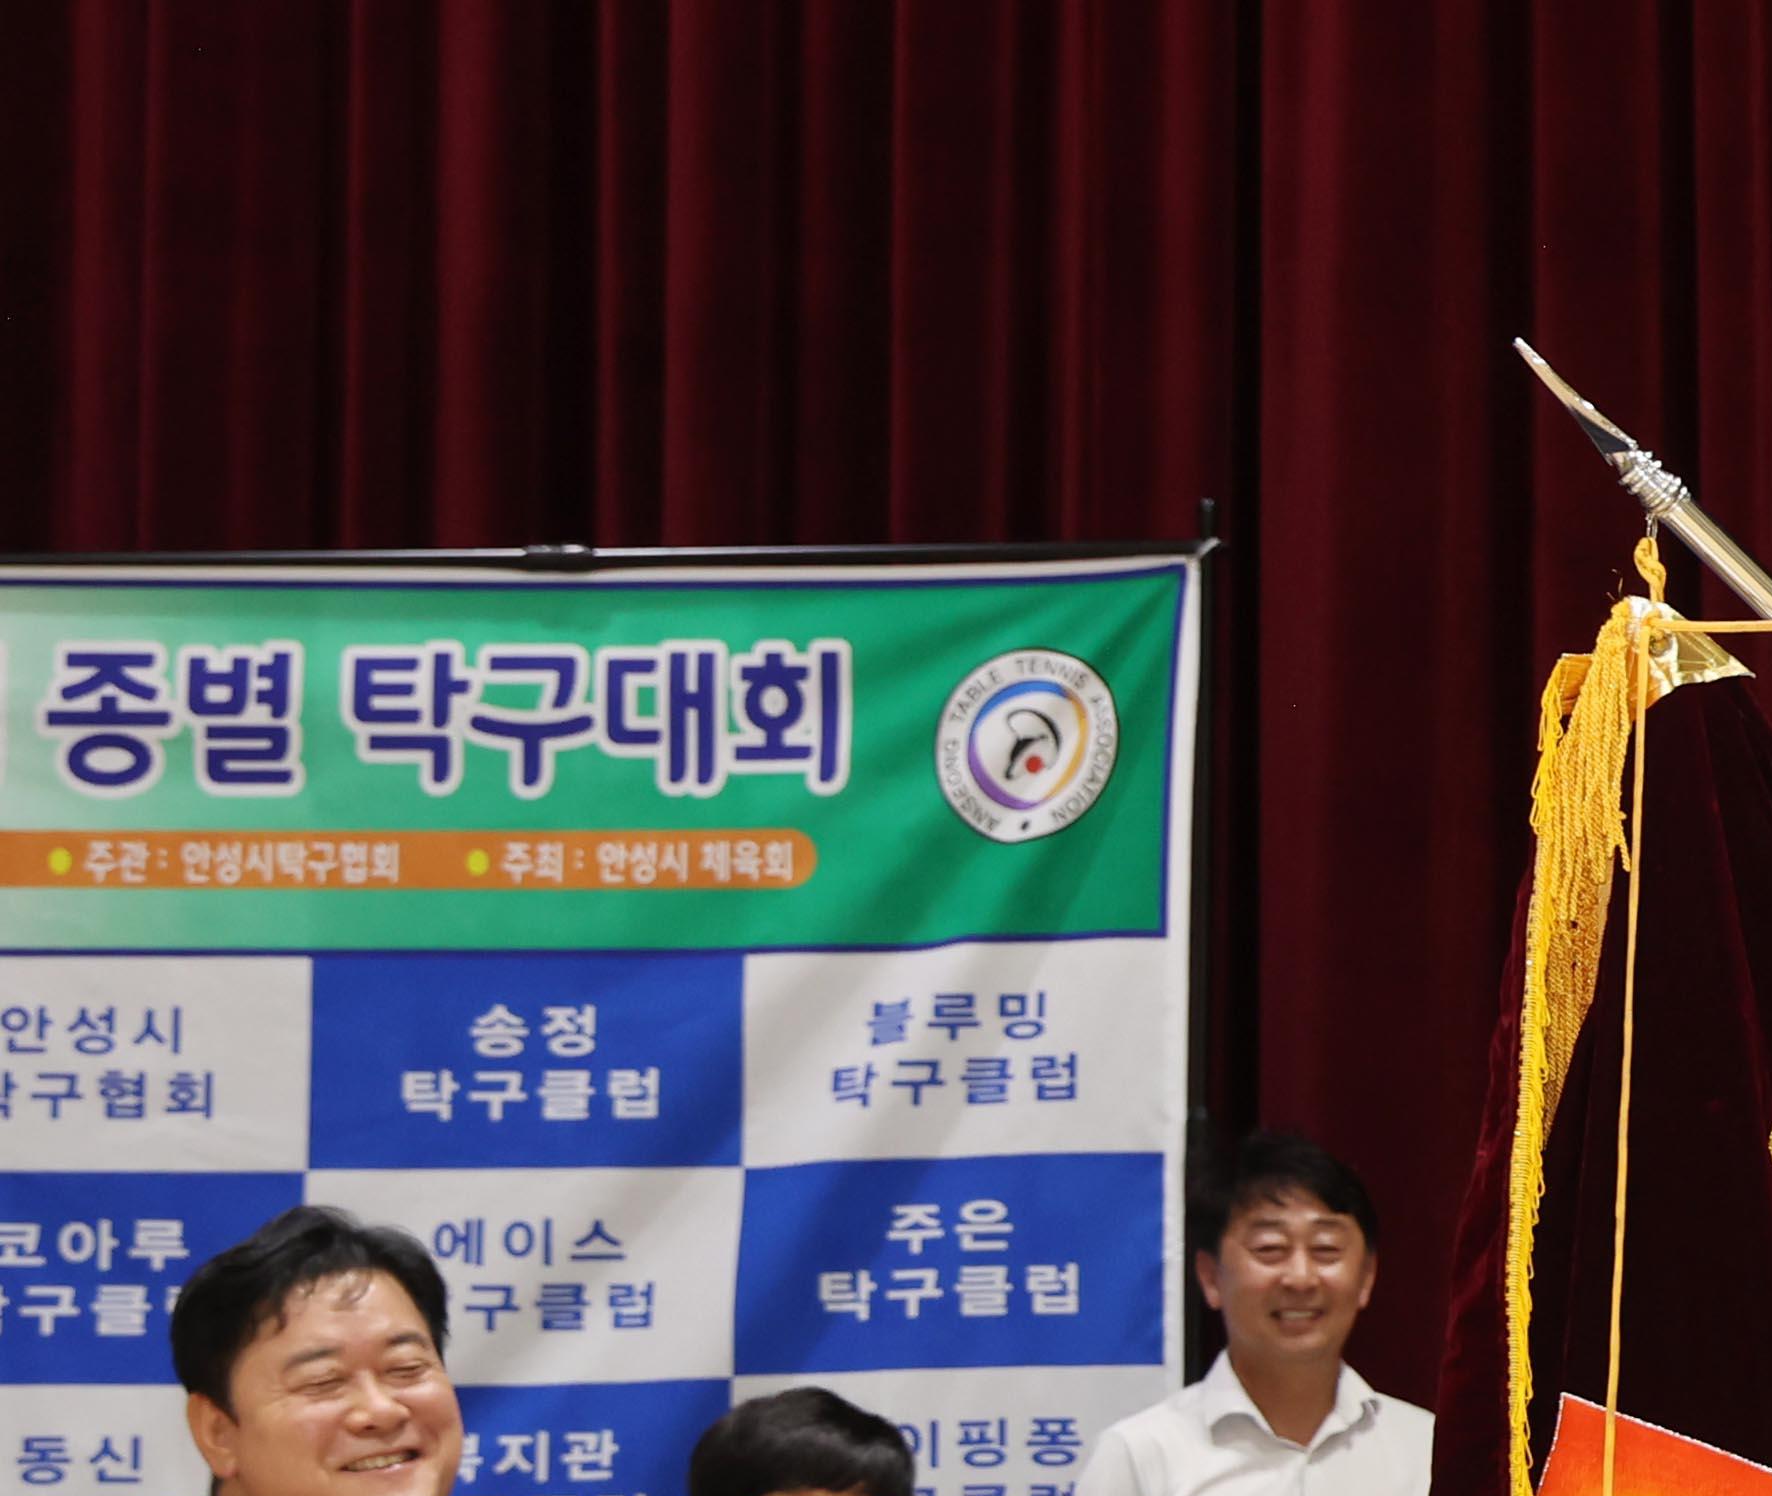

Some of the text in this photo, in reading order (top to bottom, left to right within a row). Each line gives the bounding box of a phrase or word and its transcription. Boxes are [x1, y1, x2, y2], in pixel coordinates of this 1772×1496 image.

[951, 670, 1004, 723] TABLE
[1016, 657, 1089, 689] TENNIS
[44, 645, 850, 793] 종별 탁구대회
[84, 842, 400, 884] 주관 안성시탁구협회
[500, 841, 795, 883] 주최 안성시 체육회
[1, 1005, 184, 1057] 안성시
[469, 1003, 599, 1059] 송정
[866, 990, 1049, 1047] 블루밍
[400, 1068, 661, 1122] 탁구클럽
[830, 1051, 1080, 1108] 탁구클럽
[434, 1218, 627, 1268] 에이스
[885, 1198, 1016, 1256] 주은
[464, 1280, 656, 1333] 구클럽
[817, 1261, 1081, 1323] 탁구클럽
[16, 1434, 143, 1486] 동신
[900, 1416, 1084, 1469] 이핑퐁
